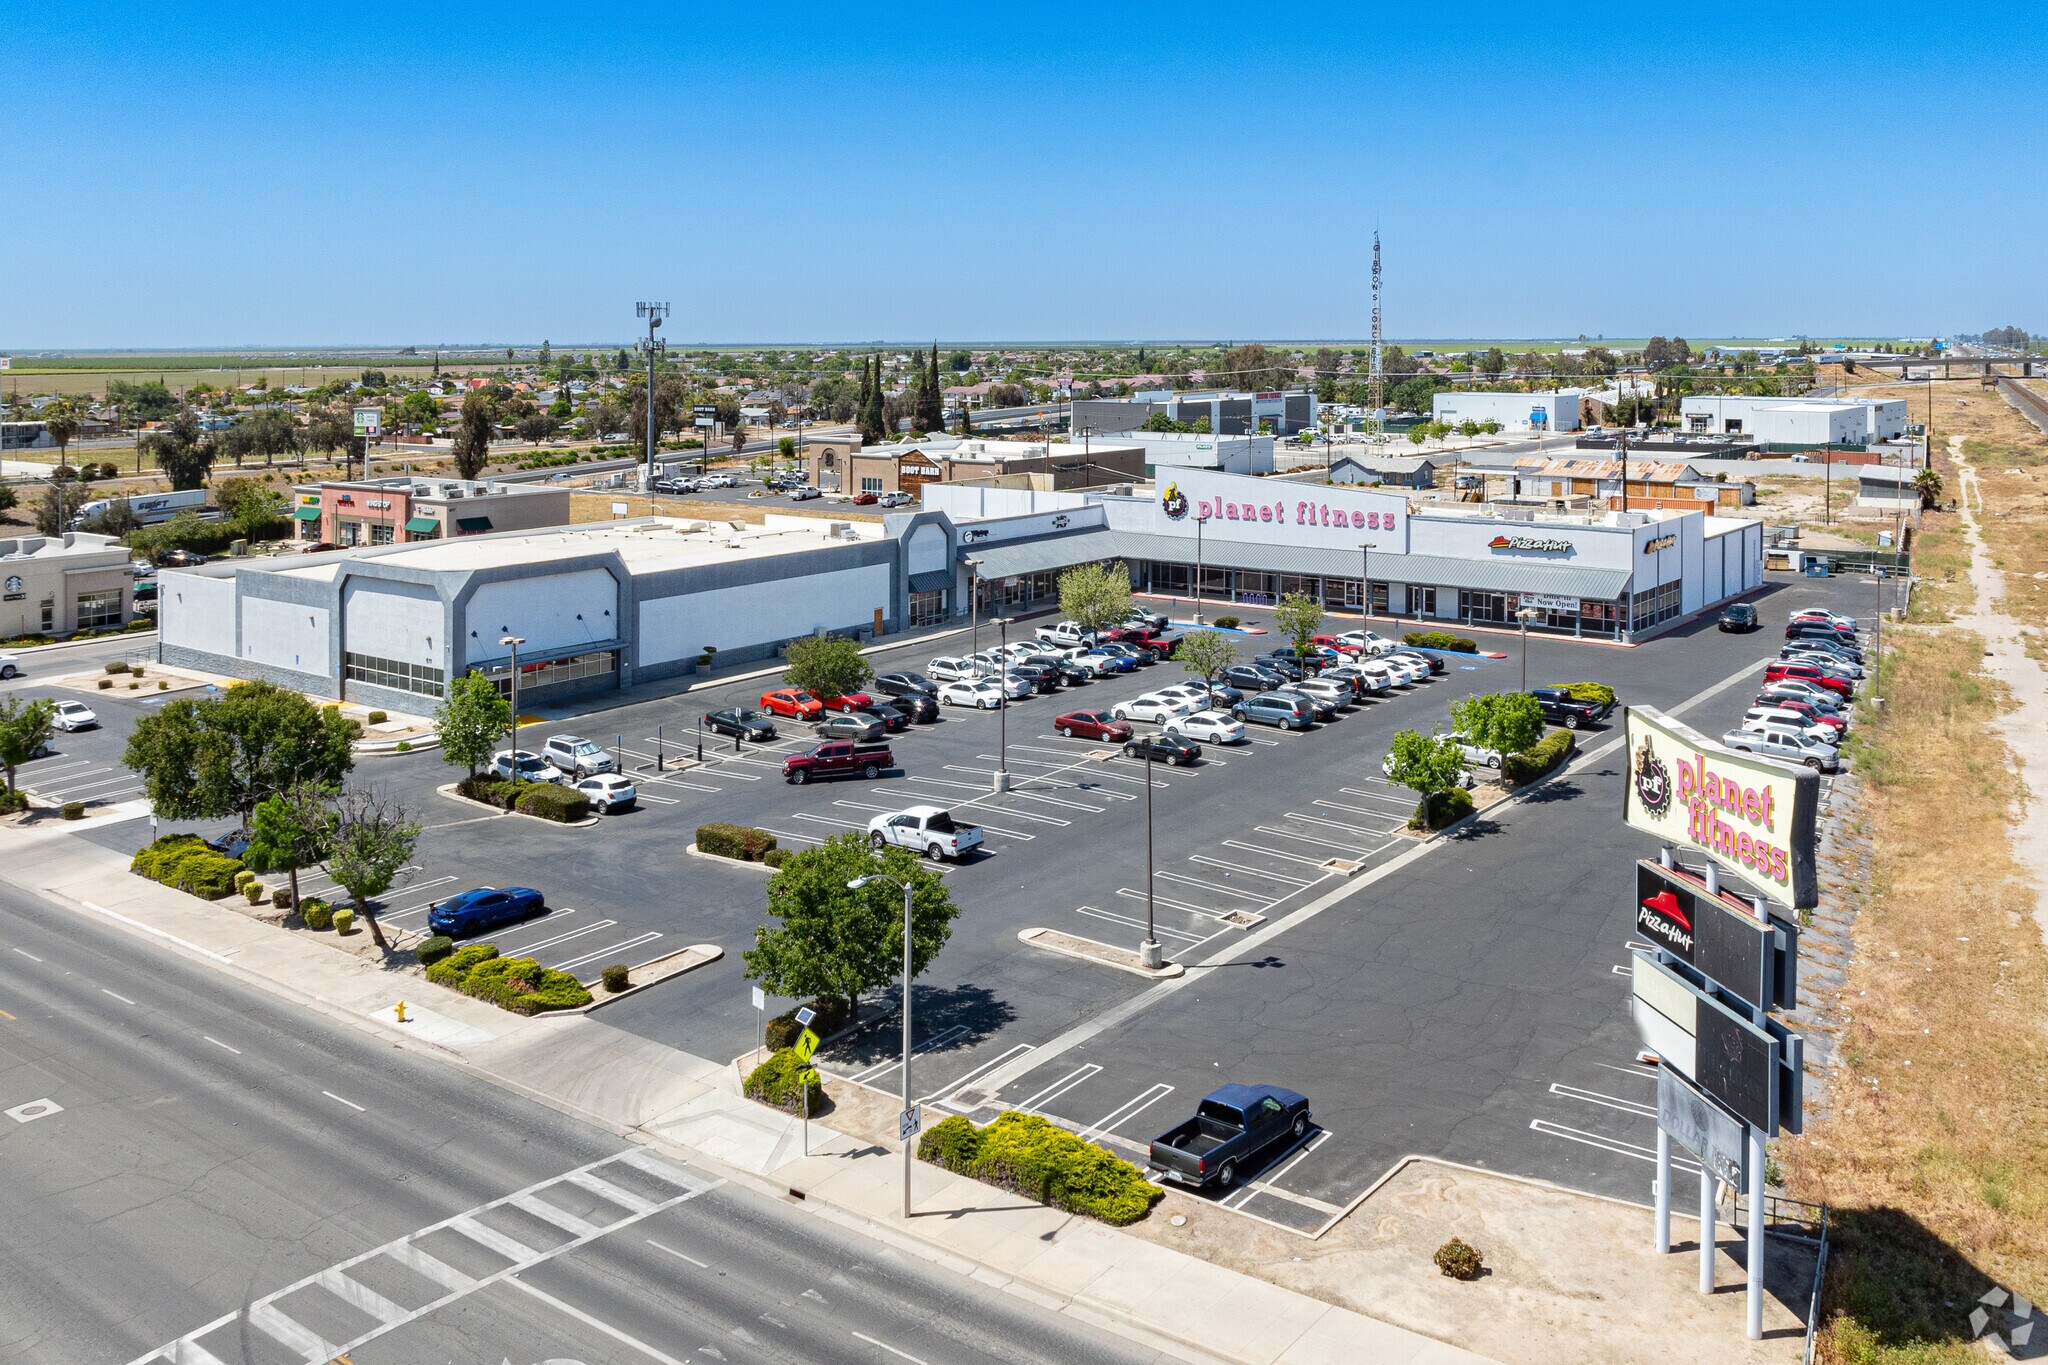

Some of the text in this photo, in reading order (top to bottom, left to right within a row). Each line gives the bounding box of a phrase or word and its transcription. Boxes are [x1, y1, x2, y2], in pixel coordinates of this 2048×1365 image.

[901, 465, 940, 476] BOOT BARN
[138, 499, 169, 510] SWIFT
[1198, 496, 1396, 530] planet fitness
[1507, 535, 1572, 553] Pizza Hut
[1537, 598, 1578, 608] Now Open!
[1640, 775, 1663, 795] pf
[1675, 753, 1775, 828] planet
[1687, 796, 1789, 882] fitness
[1638, 906, 1694, 952] Pizza Hut
